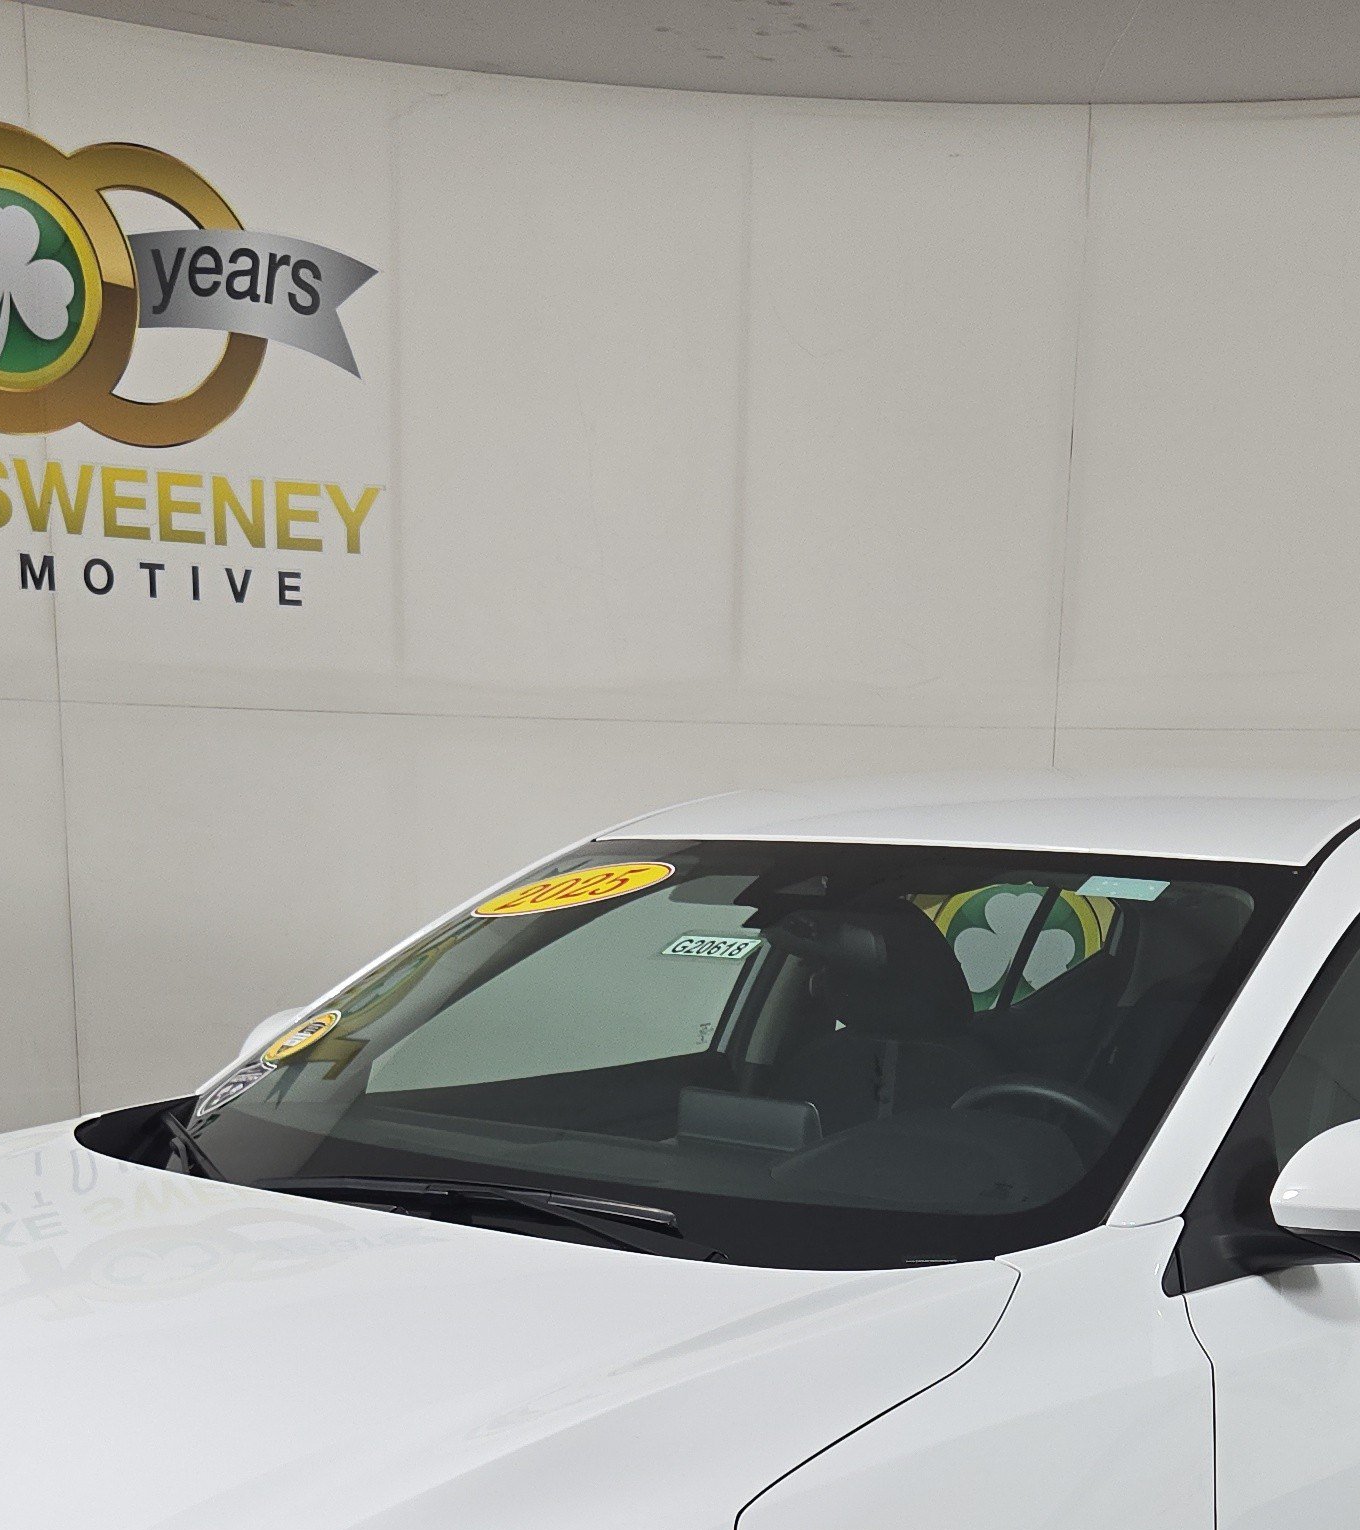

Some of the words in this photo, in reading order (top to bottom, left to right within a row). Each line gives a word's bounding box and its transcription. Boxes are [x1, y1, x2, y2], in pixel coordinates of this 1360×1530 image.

[150, 242, 322, 316] years
[493, 867, 651, 912] 2025
[671, 938, 750, 957] G20618
